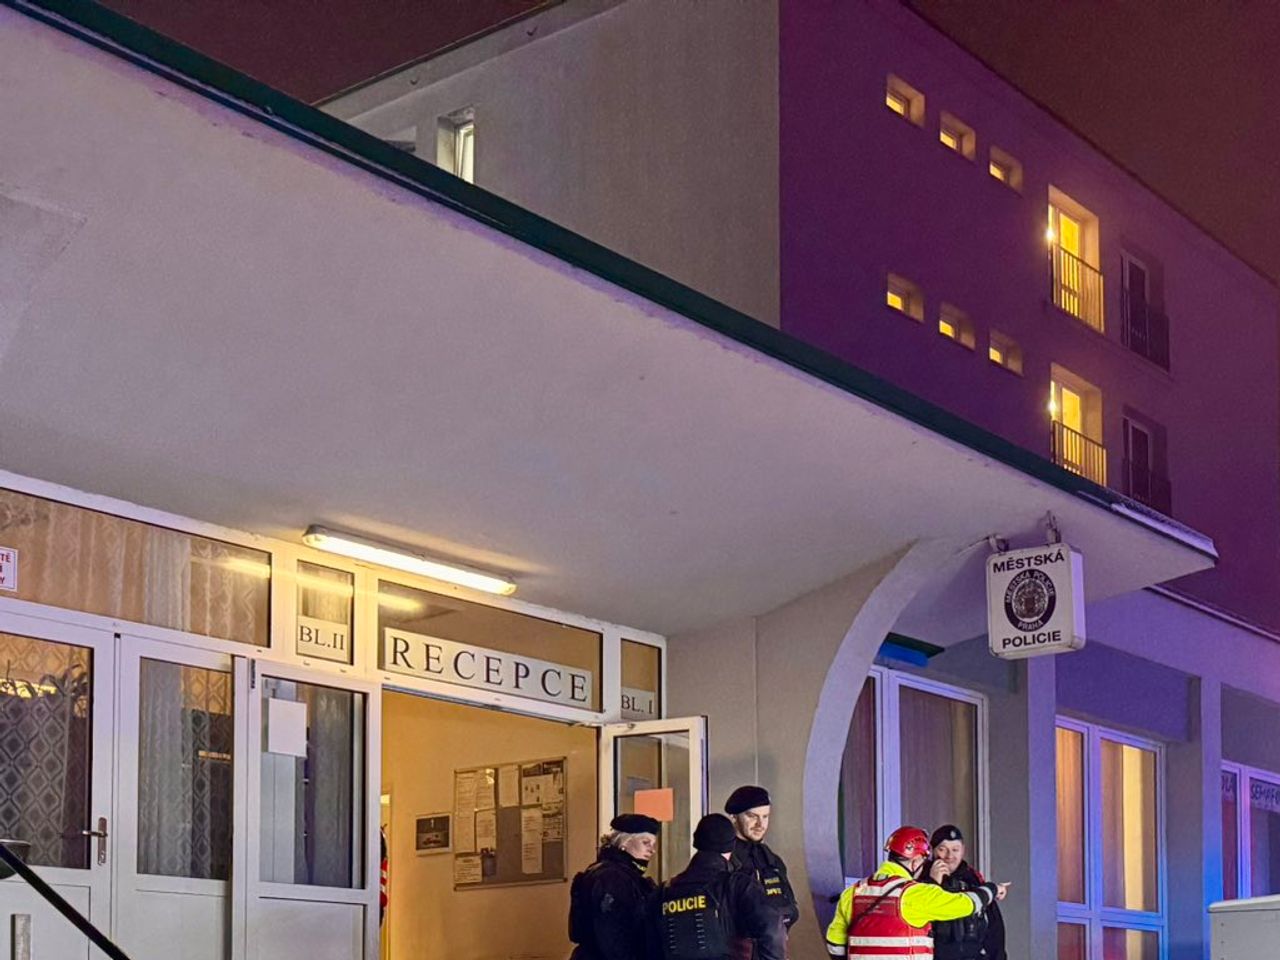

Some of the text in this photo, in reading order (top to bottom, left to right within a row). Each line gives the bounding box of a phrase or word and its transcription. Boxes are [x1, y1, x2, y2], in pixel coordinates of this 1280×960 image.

[993, 548, 1065, 573] MĚSTSKÁ
[1002, 630, 1062, 649] POLICIE
[390, 635, 588, 703] RECEPCE
[662, 895, 706, 916] POLICIE
